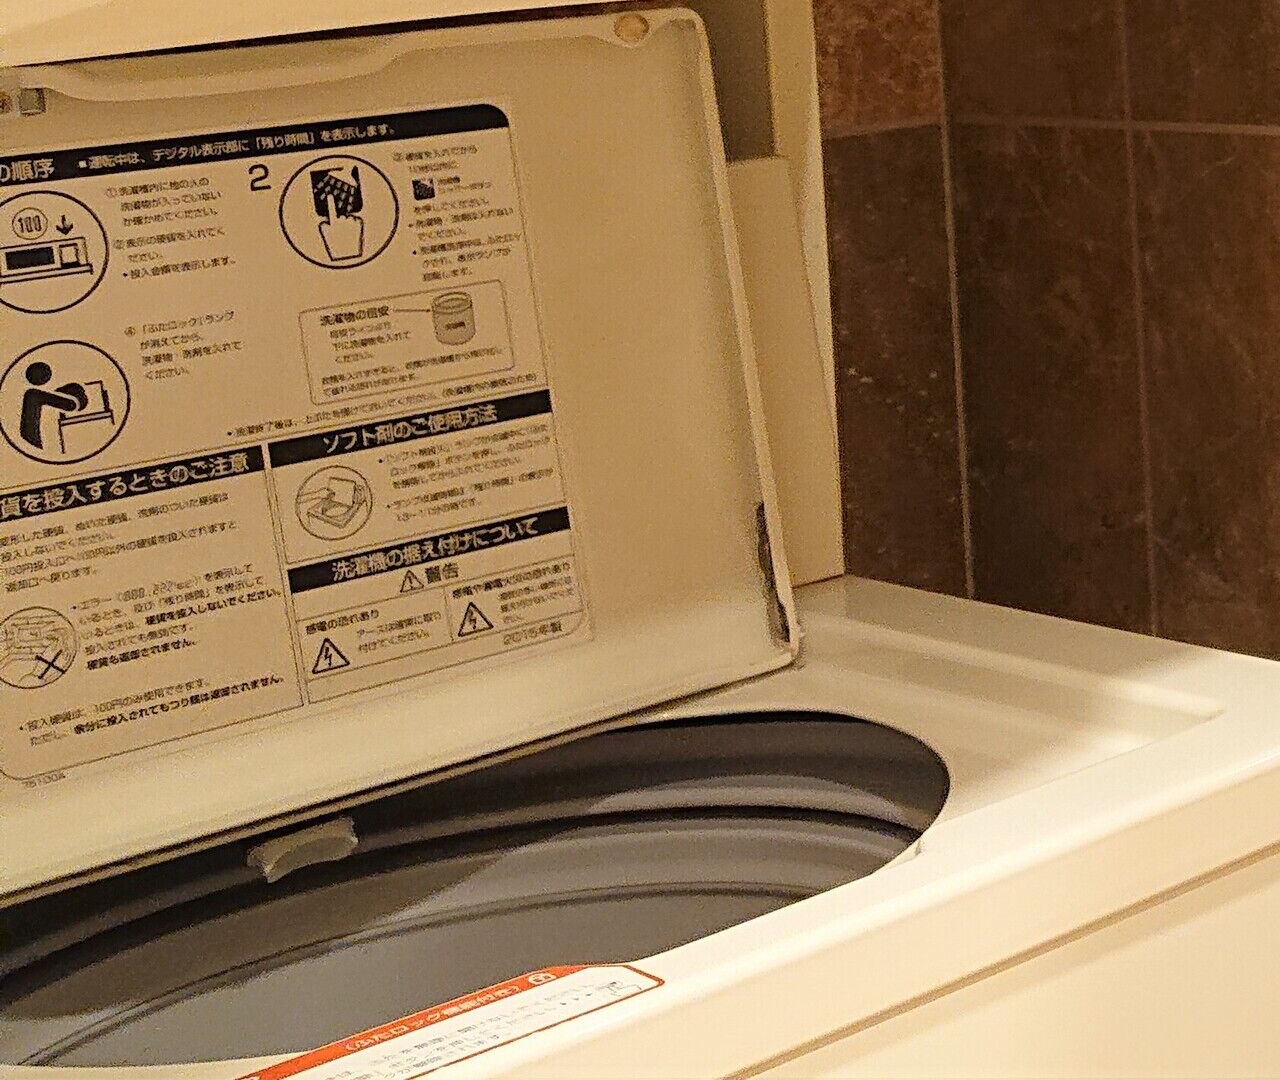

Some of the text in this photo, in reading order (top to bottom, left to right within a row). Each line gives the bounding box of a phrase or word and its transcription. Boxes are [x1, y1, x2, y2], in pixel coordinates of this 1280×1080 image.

[248, 163, 271, 192] 2
[324, 404, 498, 453] ソフト剤のご使用方法
[332, 517, 539, 582] 洗濯機の据え付けについて
